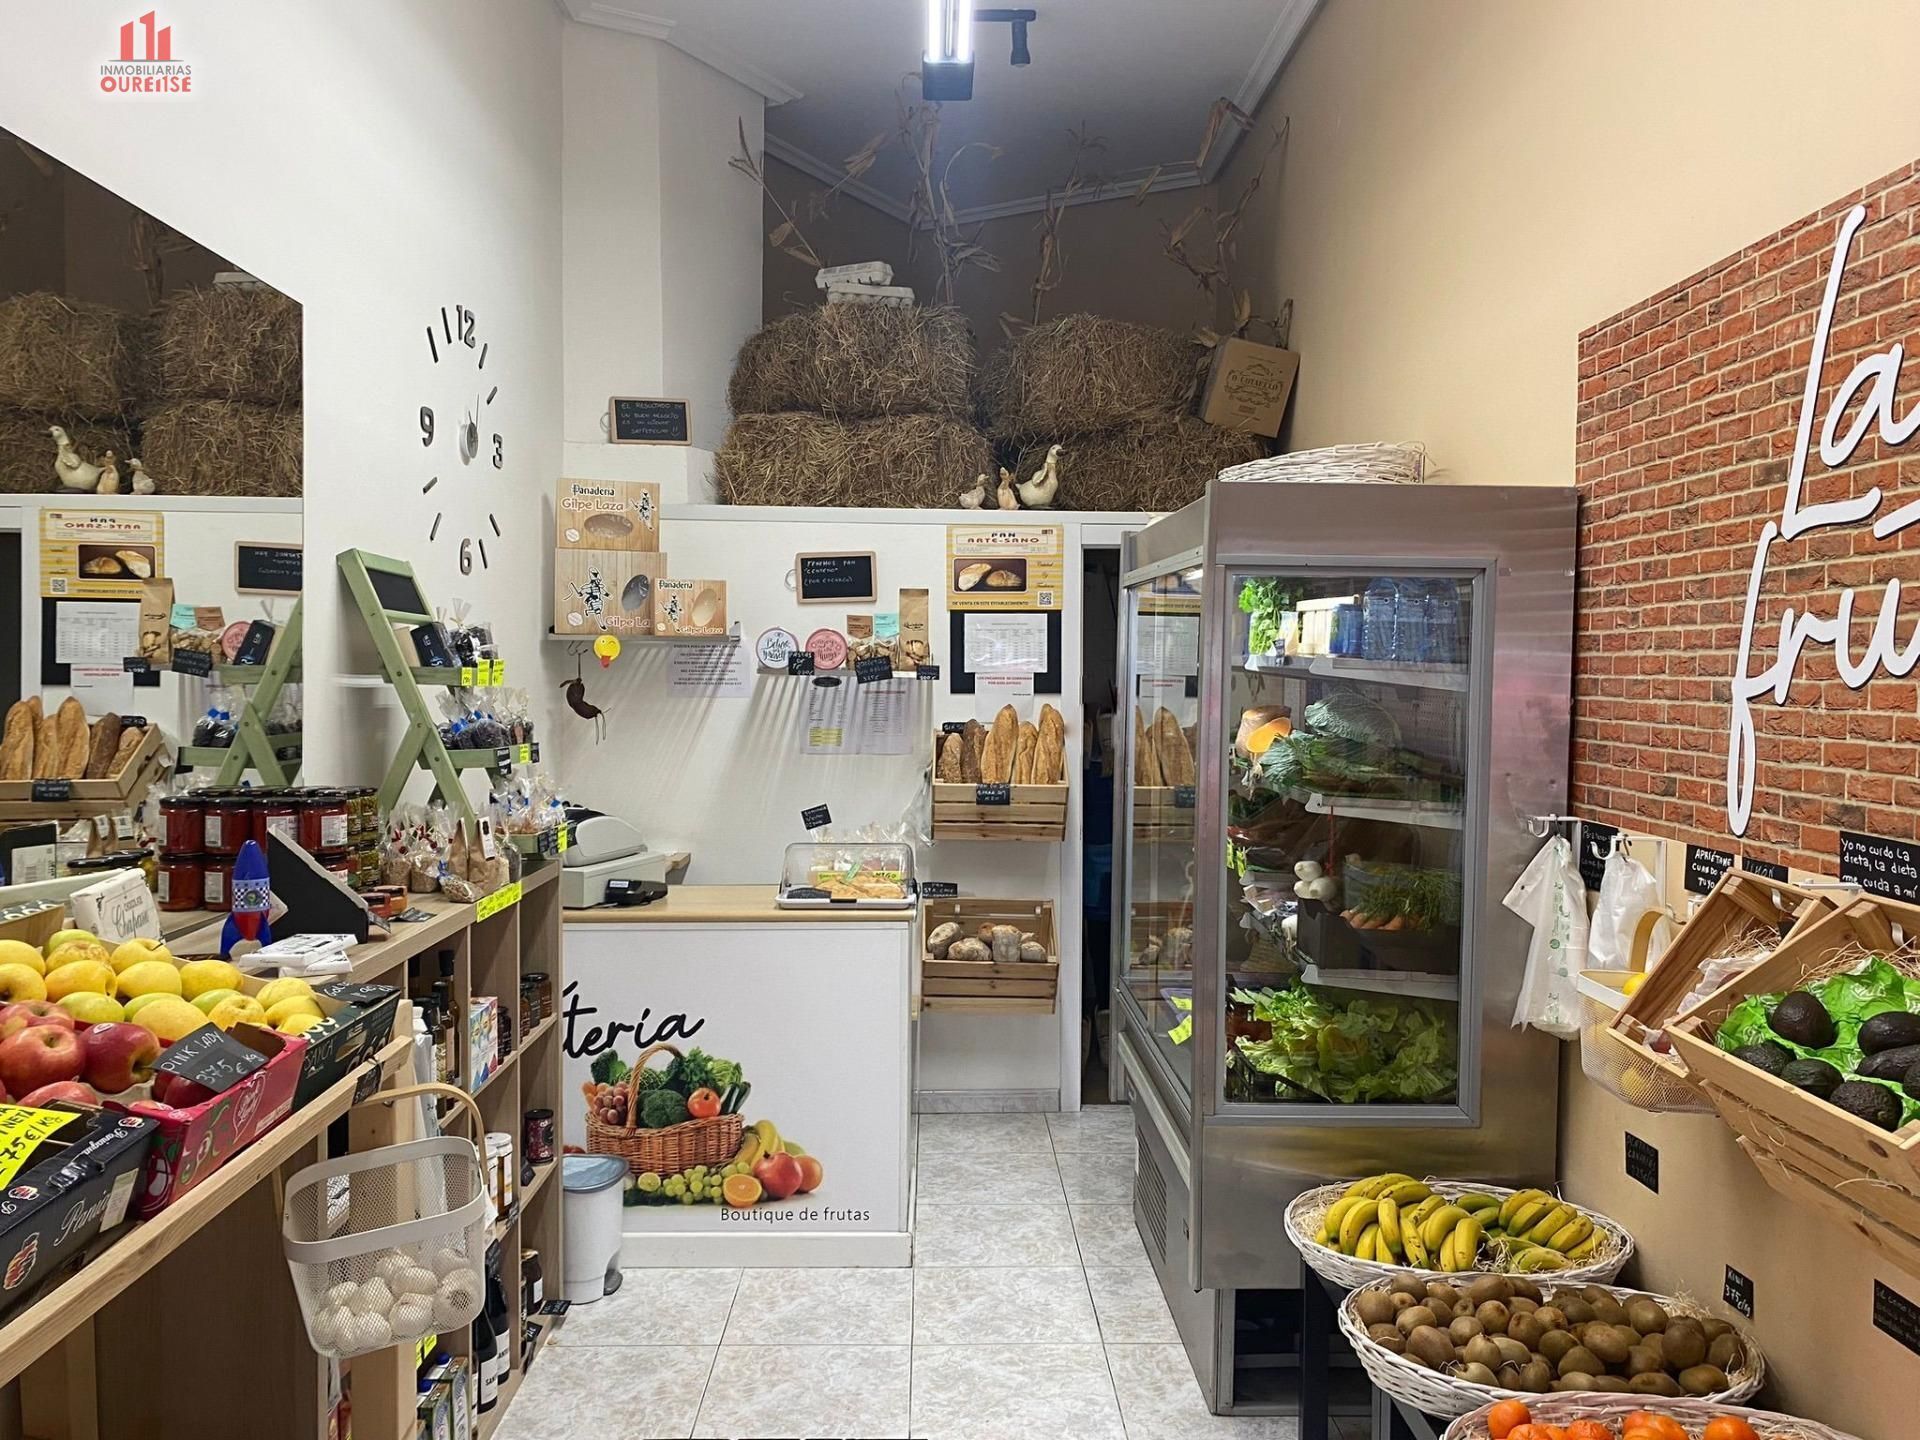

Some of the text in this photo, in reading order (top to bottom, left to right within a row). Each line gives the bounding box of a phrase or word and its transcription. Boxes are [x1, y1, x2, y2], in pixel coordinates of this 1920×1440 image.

[455, 304, 476, 349] 12
[419, 405, 435, 447] 9
[492, 433, 504, 471] 3
[562, 498, 624, 511] Gilpe Laza
[459, 537, 473, 576] 6
[605, 616, 633, 628] Gilpe
[1855, 842, 1867, 853] no
[1868, 845, 1894, 859] cuido
[1843, 852, 1872, 872] dieta,
[1891, 862, 1918, 879] dieta
[1697, 877, 1716, 890] TUYO
[1842, 874, 1918, 899] me cuida a mí
[160, 1028, 225, 1075] PINK LADY
[234, 1062, 249, 1074] €
[721, 1206, 870, 1224] Boutique de frutas
